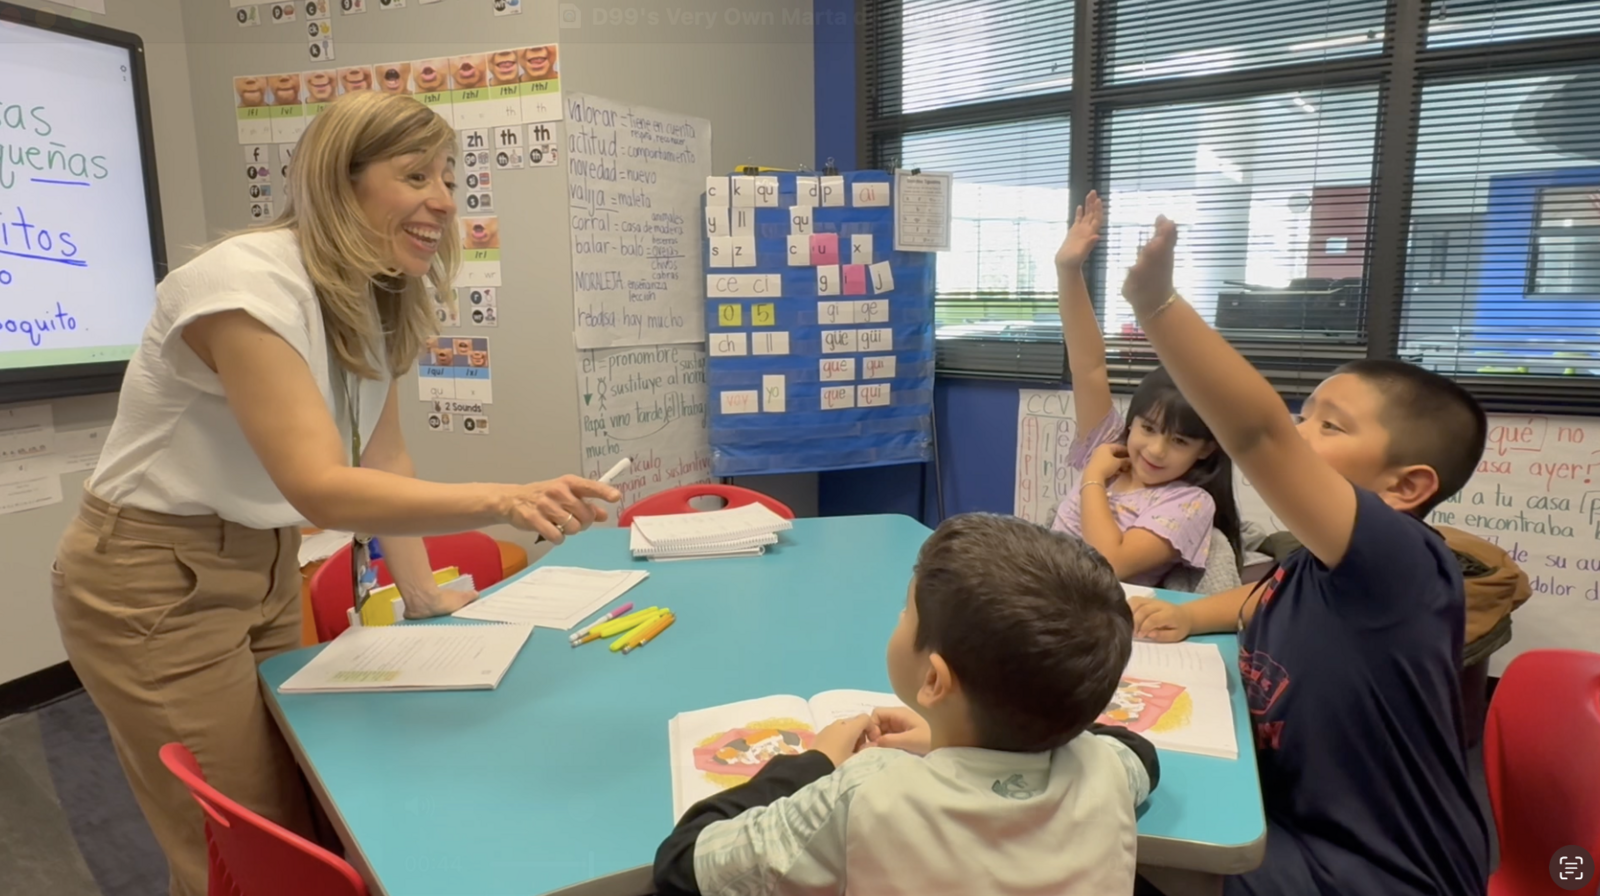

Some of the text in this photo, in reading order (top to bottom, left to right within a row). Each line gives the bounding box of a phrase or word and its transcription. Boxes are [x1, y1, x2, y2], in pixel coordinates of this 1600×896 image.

[462, 90, 478, 100] /zh/
[500, 86, 517, 96] /th/
[531, 82, 548, 92] /th/
[0, 104, 52, 136] as
[467, 131, 484, 148] zh
[500, 128, 517, 146] th
[534, 124, 550, 142] th
[568, 125, 617, 158] actitud
[253, 147, 260, 162] f
[569, 158, 657, 184] novedad nuevo
[708, 187, 716, 196] c
[733, 178, 741, 196] k
[756, 186, 774, 203] qu
[808, 184, 818, 197] d
[823, 186, 832, 203] p
[618, 188, 652, 208] maleta
[572, 212, 610, 232] corral
[621, 221, 642, 232] casa
[708, 216, 716, 233] y
[792, 216, 809, 232] qu
[575, 234, 610, 254] balar
[712, 246, 720, 256] s
[734, 246, 742, 256] z
[789, 245, 798, 254] c
[818, 244, 826, 254] u
[853, 244, 862, 254] x
[716, 275, 769, 293] ce ci
[819, 276, 828, 292] g
[757, 304, 770, 322] 5
[826, 302, 839, 323] gi
[860, 302, 878, 322] ge
[622, 306, 642, 340] hay
[648, 306, 684, 328] mucho
[718, 334, 736, 352] ch
[608, 344, 678, 382] pronombre
[610, 372, 662, 397] sustituye
[667, 366, 679, 385] al
[766, 386, 780, 404] yo
[824, 388, 846, 408] que
[860, 384, 882, 405] qui
[444, 402, 482, 413] 2 Sounds
[610, 412, 630, 428] vino
[1060, 420, 1070, 434] a
[1058, 434, 1070, 448] e
[1488, 418, 1584, 456] qué no
[1044, 460, 1052, 476] r
[1058, 482, 1068, 496] u
[1472, 492, 1484, 506] a
[1495, 484, 1513, 508] tu
[1526, 495, 1570, 512] casa
[1464, 510, 1575, 538] encontraba
[1544, 554, 1568, 568] su
[1530, 575, 1577, 596] dolor
